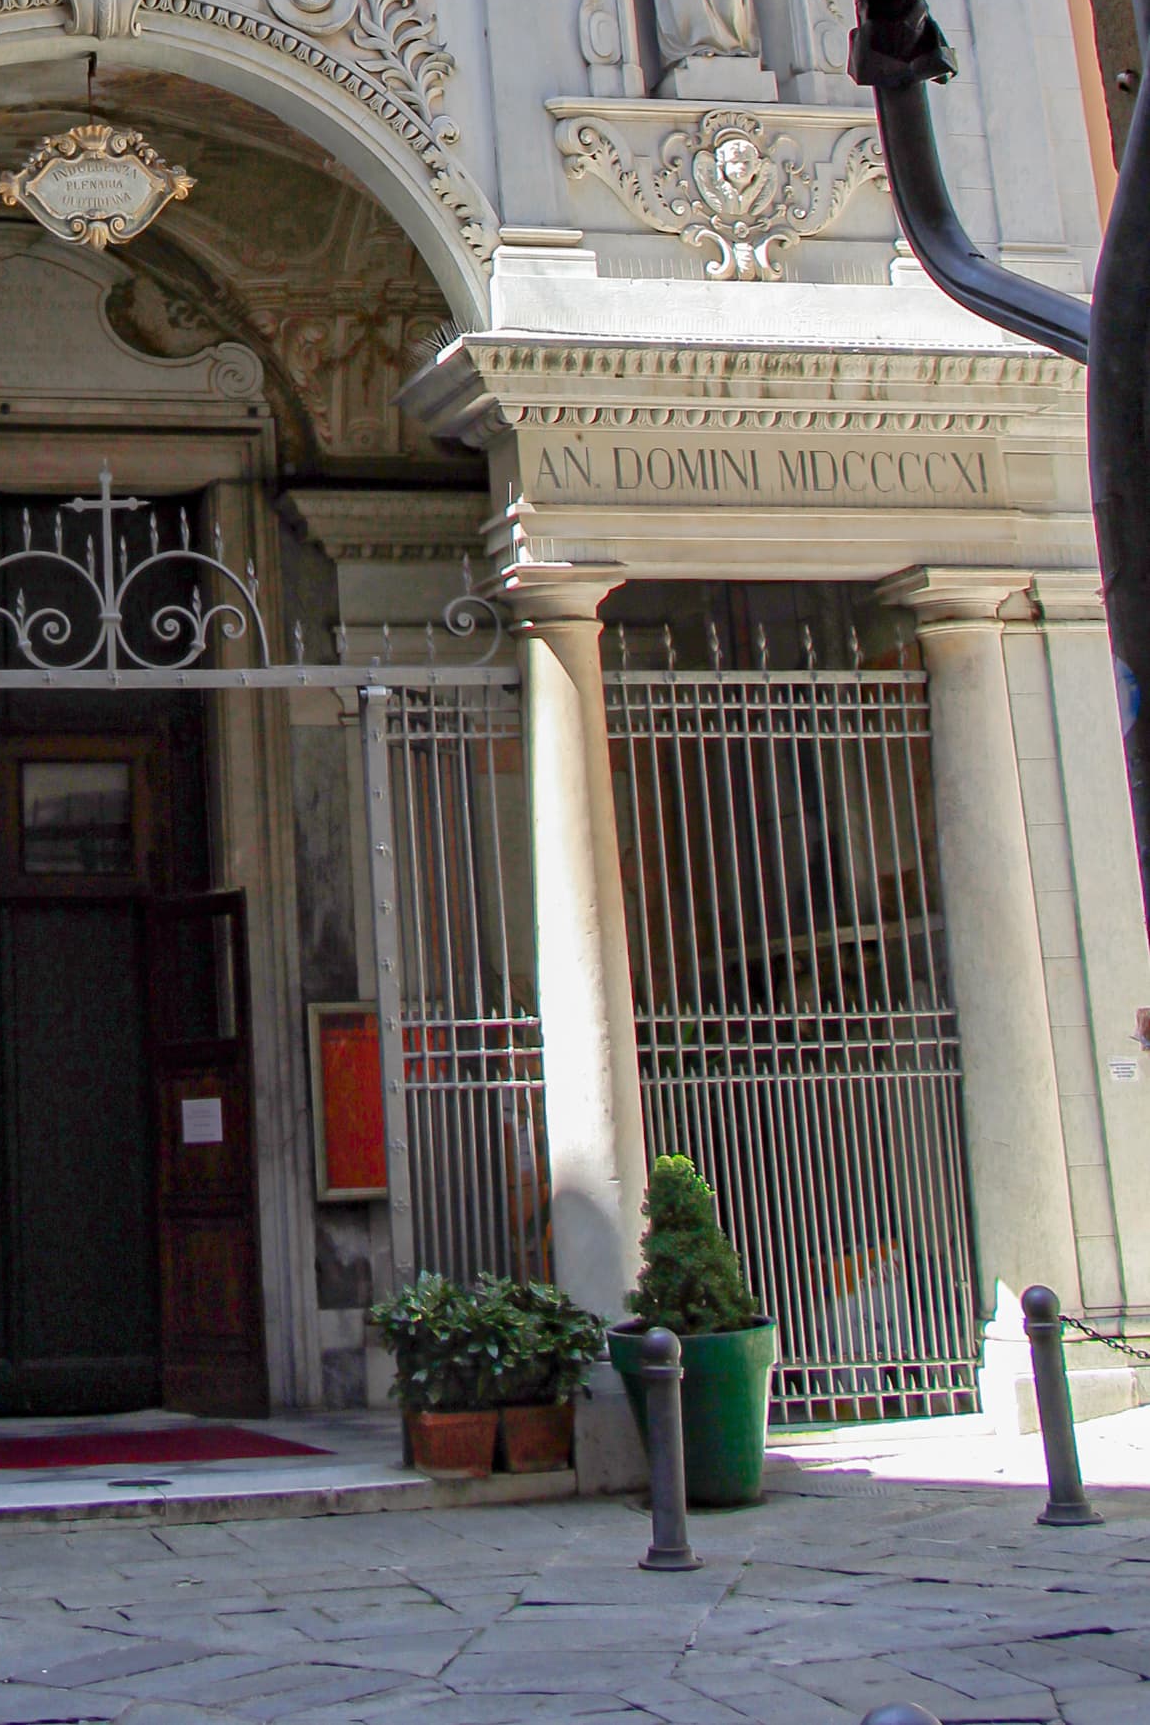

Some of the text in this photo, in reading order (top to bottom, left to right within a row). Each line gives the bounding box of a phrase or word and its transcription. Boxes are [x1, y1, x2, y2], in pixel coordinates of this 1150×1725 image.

[536, 446, 988, 494] AN. DOMINI MDCCCCXI
